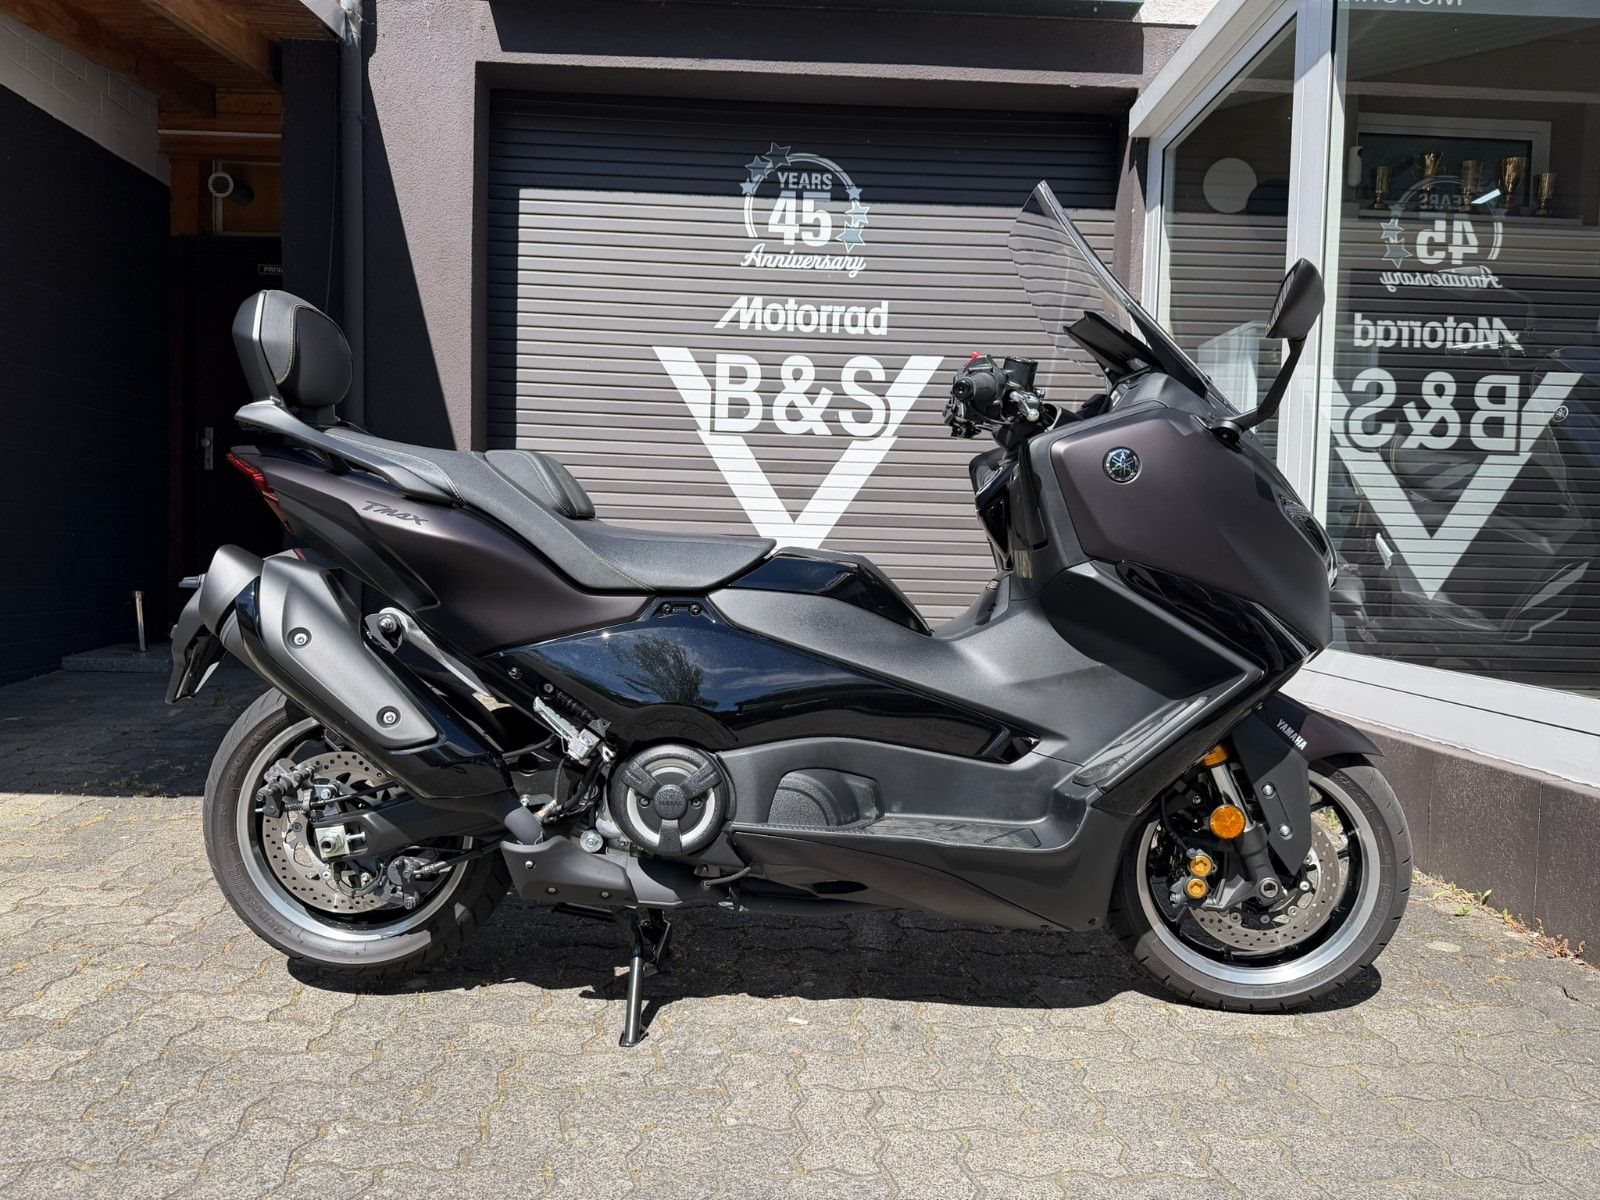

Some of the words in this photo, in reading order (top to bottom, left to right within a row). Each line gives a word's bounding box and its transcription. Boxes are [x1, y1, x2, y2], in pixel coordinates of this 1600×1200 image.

[777, 171, 833, 190] YEARS
[768, 190, 832, 247] 45
[740, 243, 866, 278] Anniversary
[713, 296, 888, 336] Motorrad
[714, 353, 887, 437] B&S
[362, 500, 429, 526] TMAX
[1276, 718, 1308, 751] YAMAHA
